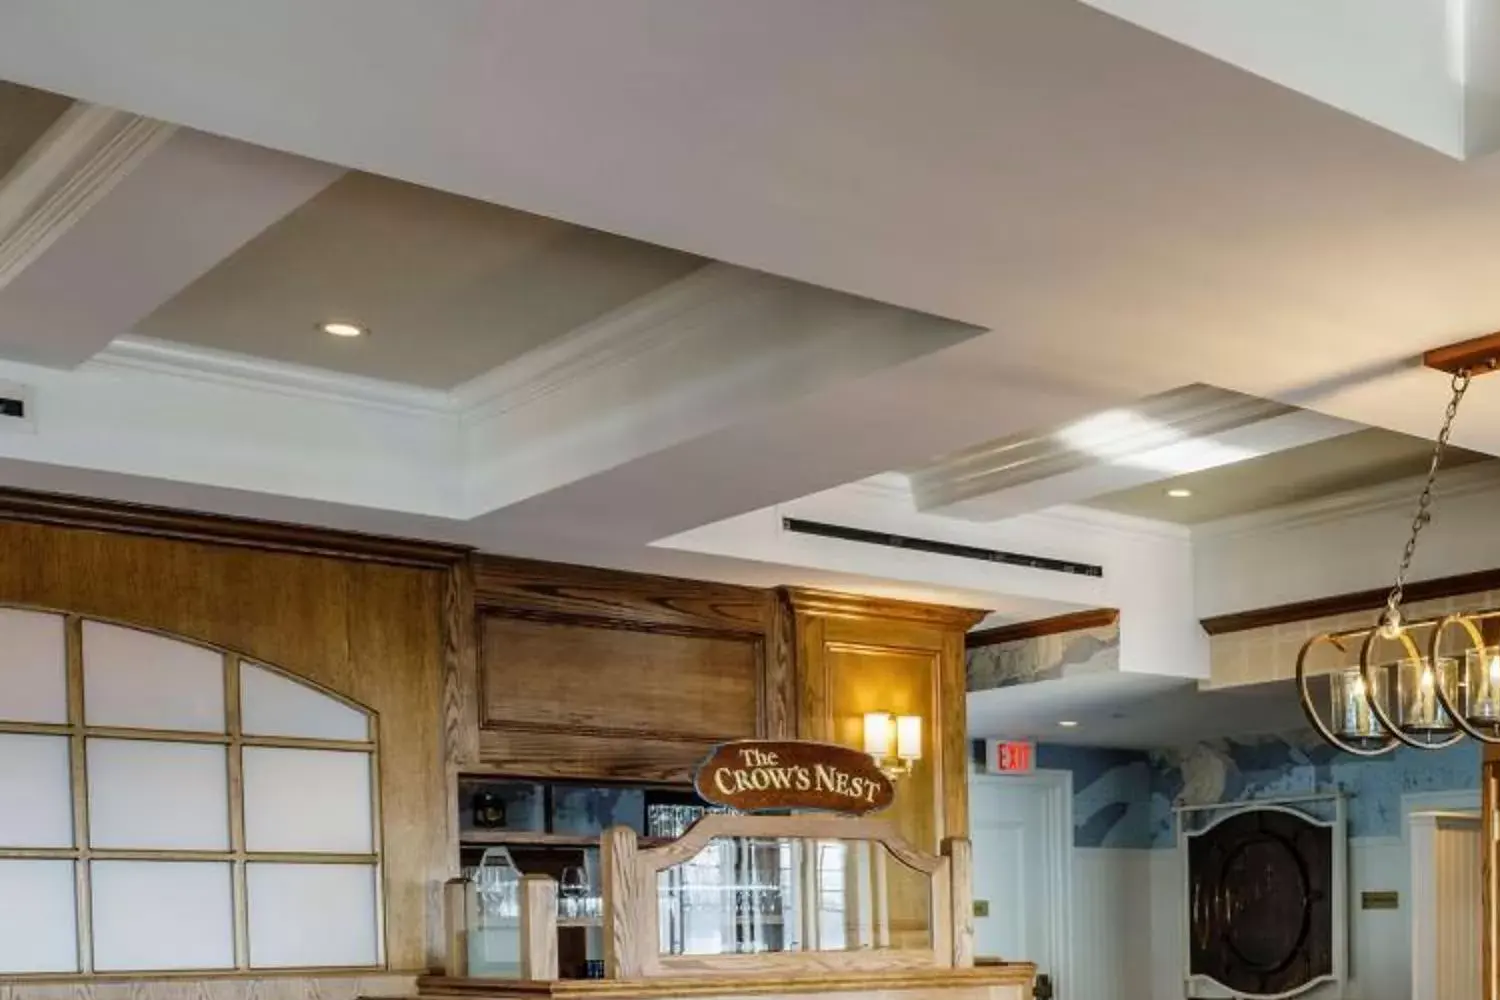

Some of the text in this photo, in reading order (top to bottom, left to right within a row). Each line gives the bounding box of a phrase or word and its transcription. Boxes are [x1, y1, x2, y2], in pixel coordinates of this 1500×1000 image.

[739, 748, 779, 767] The
[998, 743, 1031, 770] EXIT
[714, 763, 881, 803] CROW'S NEST
